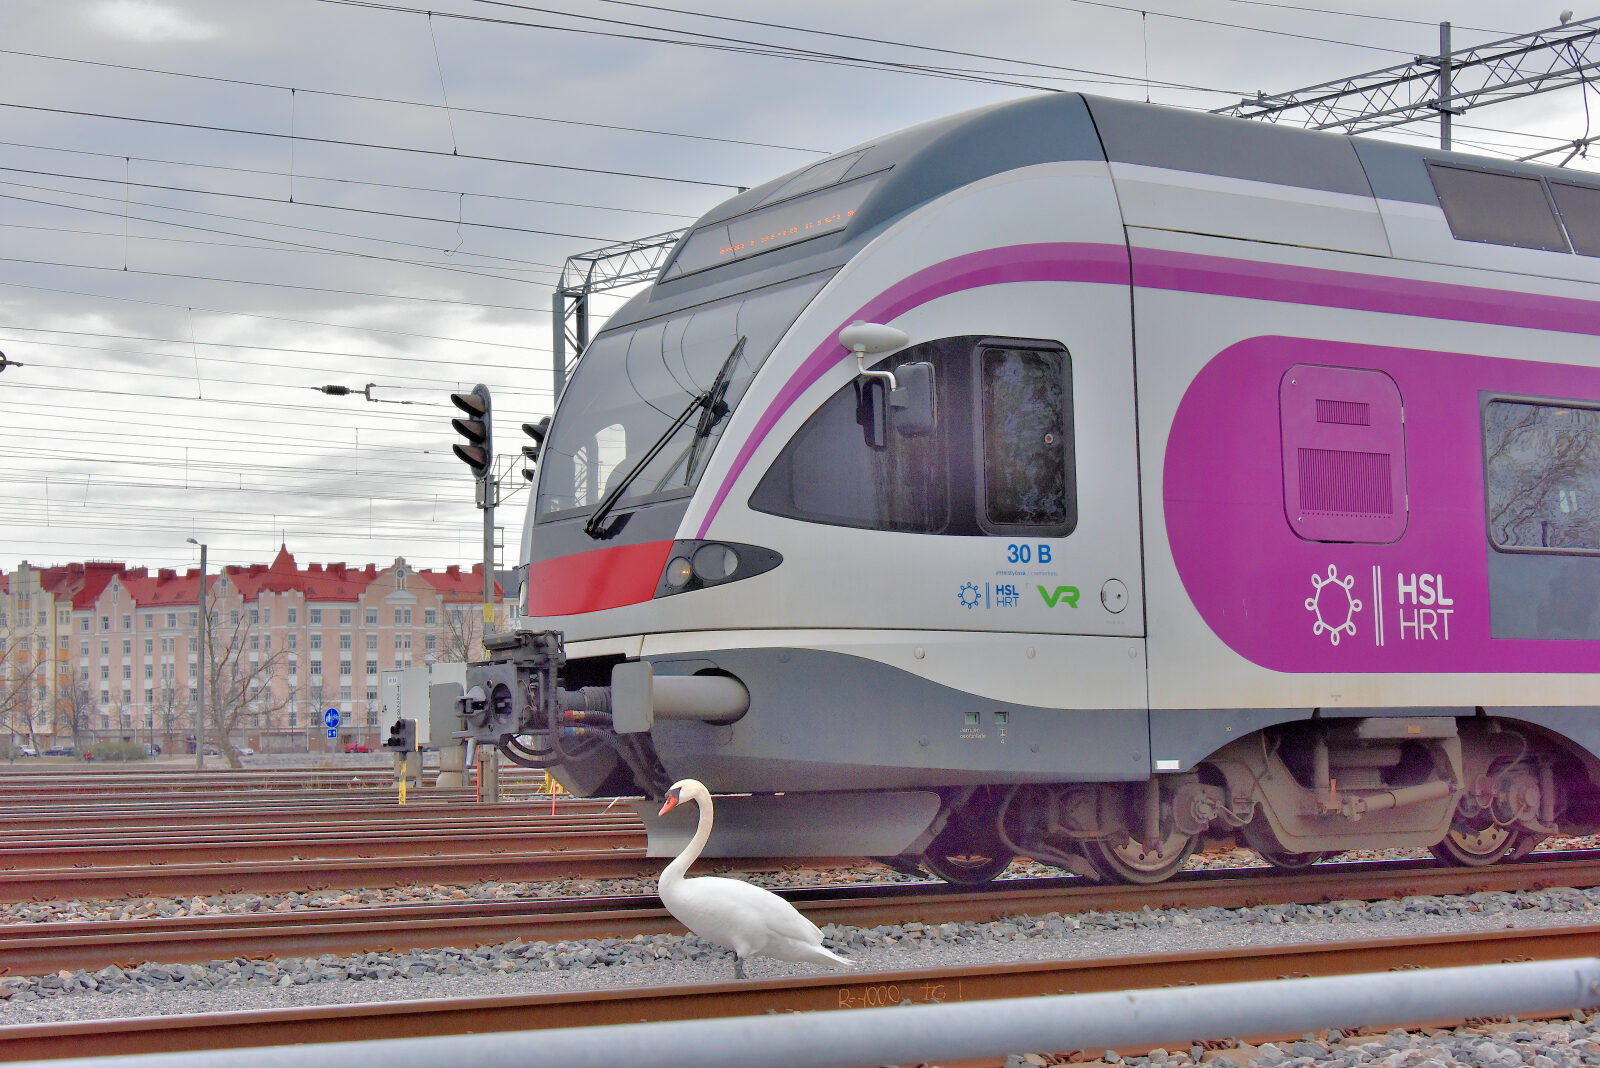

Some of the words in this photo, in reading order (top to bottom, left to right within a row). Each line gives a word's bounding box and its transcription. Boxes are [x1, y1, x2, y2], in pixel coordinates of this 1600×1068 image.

[1007, 544, 1031, 563] 30
[1038, 545, 1052, 563] B
[996, 585, 1019, 596] HSL
[1036, 585, 1080, 608] VR
[1397, 573, 1454, 605] HSL
[996, 596, 1019, 607] HRT
[1399, 608, 1454, 640] HRT
